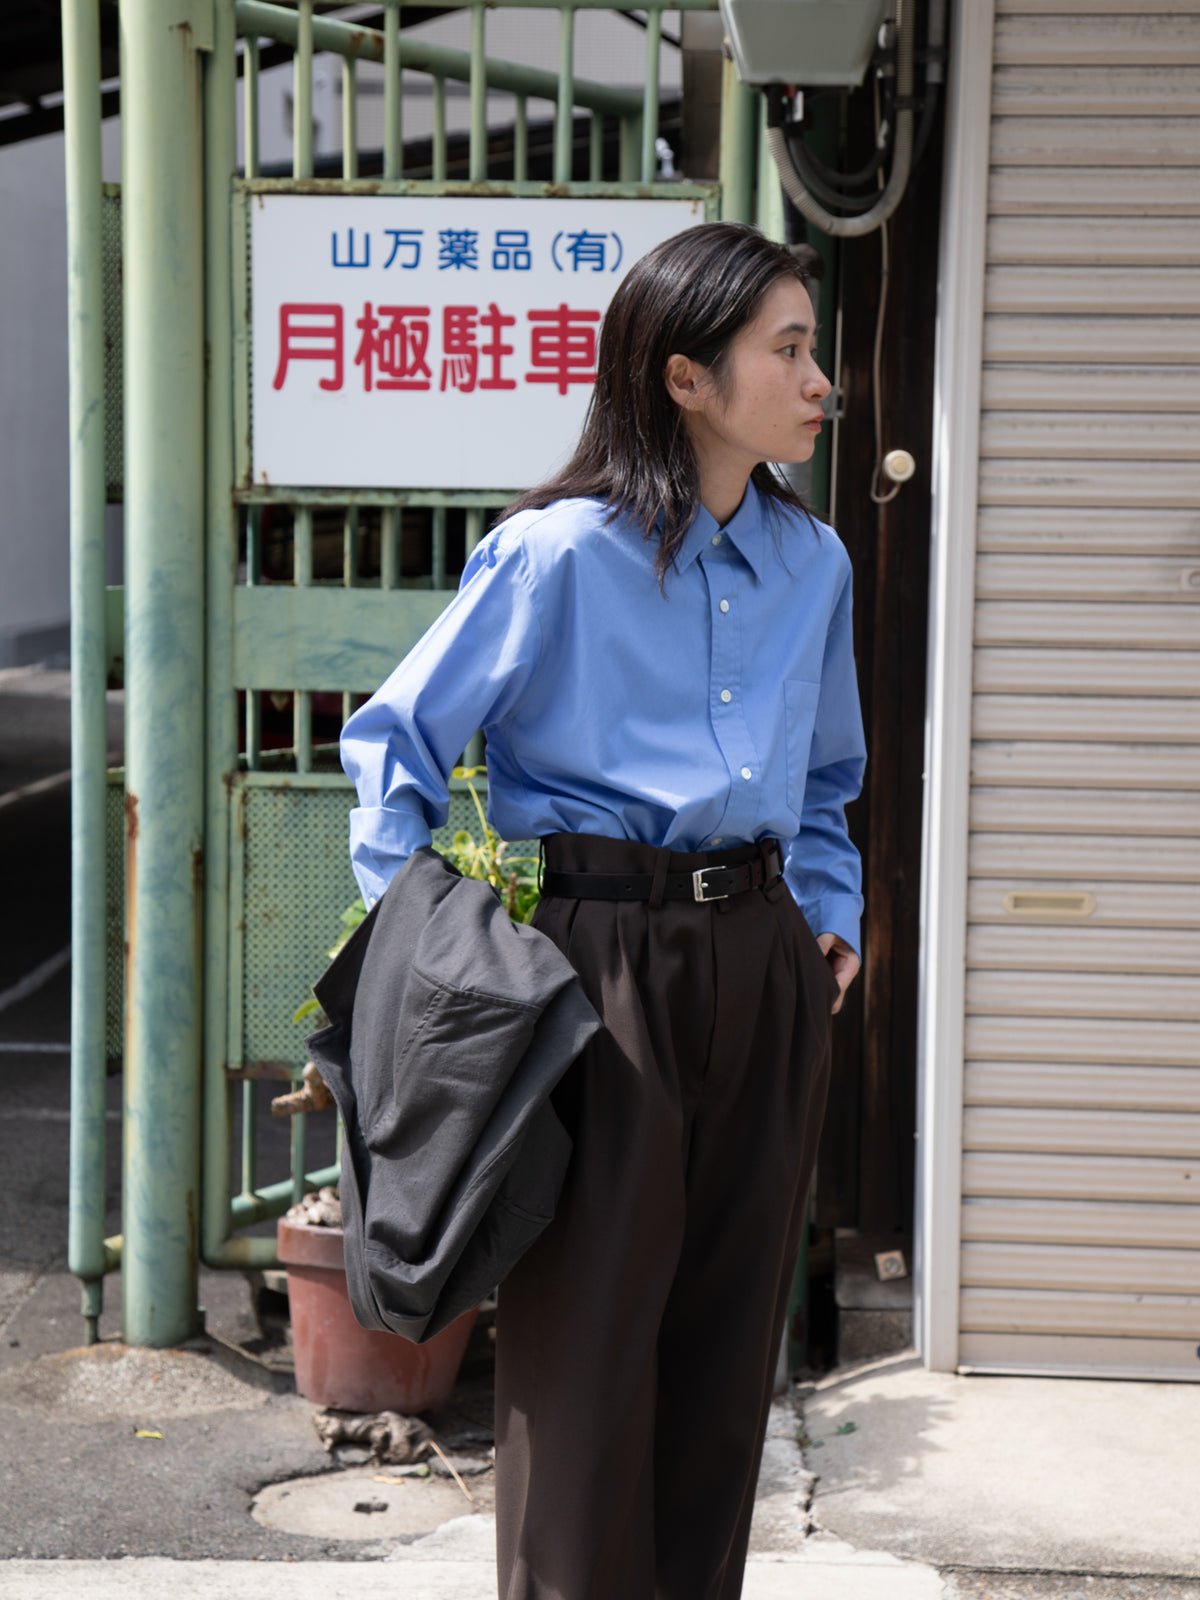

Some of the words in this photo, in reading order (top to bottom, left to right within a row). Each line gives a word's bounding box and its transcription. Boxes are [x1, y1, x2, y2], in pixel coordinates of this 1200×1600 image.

[332, 228, 623, 272] 山万薬品(有)
[272, 301, 601, 395] 月極駐車
